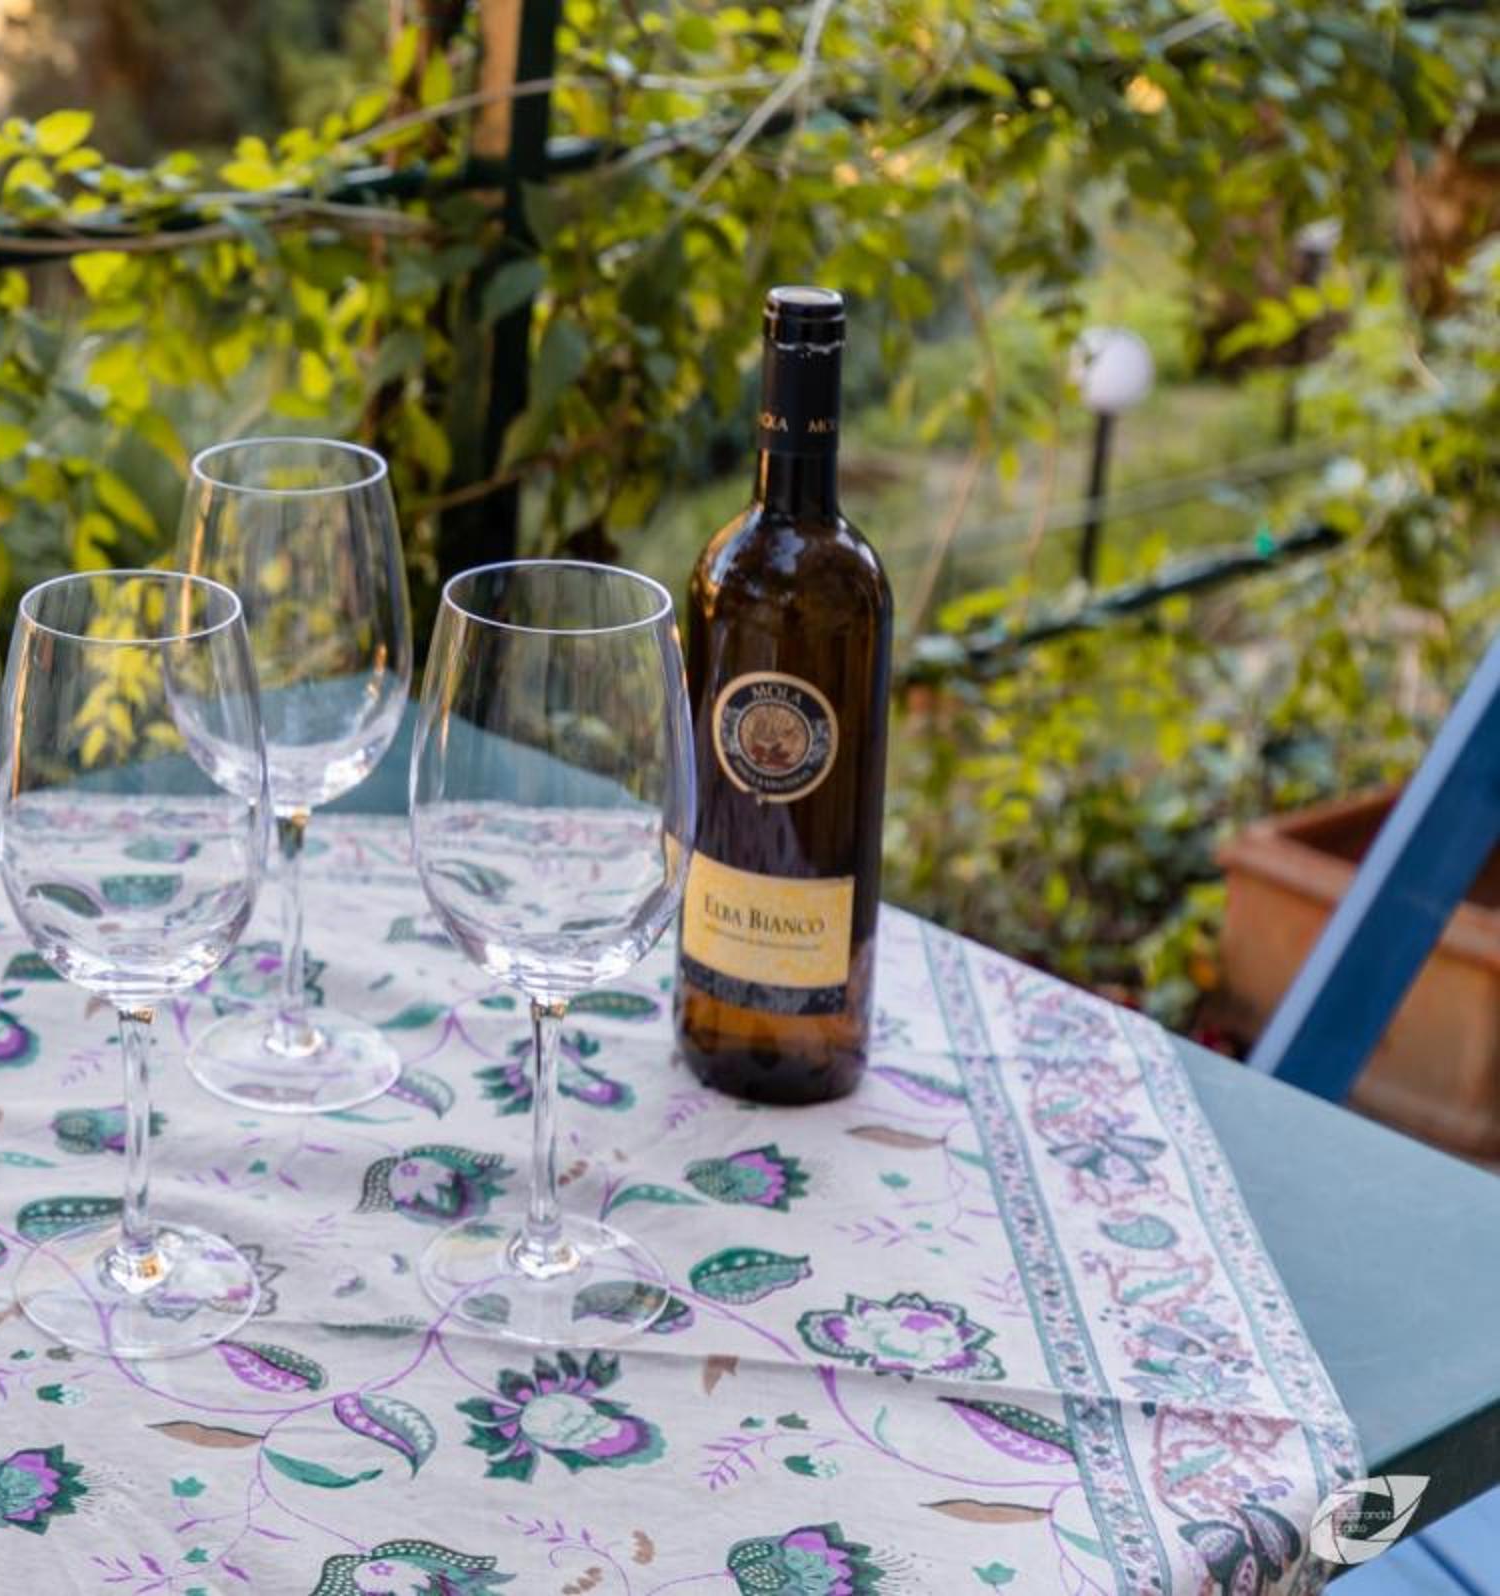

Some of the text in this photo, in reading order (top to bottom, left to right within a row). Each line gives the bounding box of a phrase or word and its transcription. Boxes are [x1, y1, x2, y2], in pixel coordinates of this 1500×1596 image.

[758, 412, 788, 432] OLA
[752, 684, 802, 704] MOLA
[749, 907, 825, 935] BIANCO
